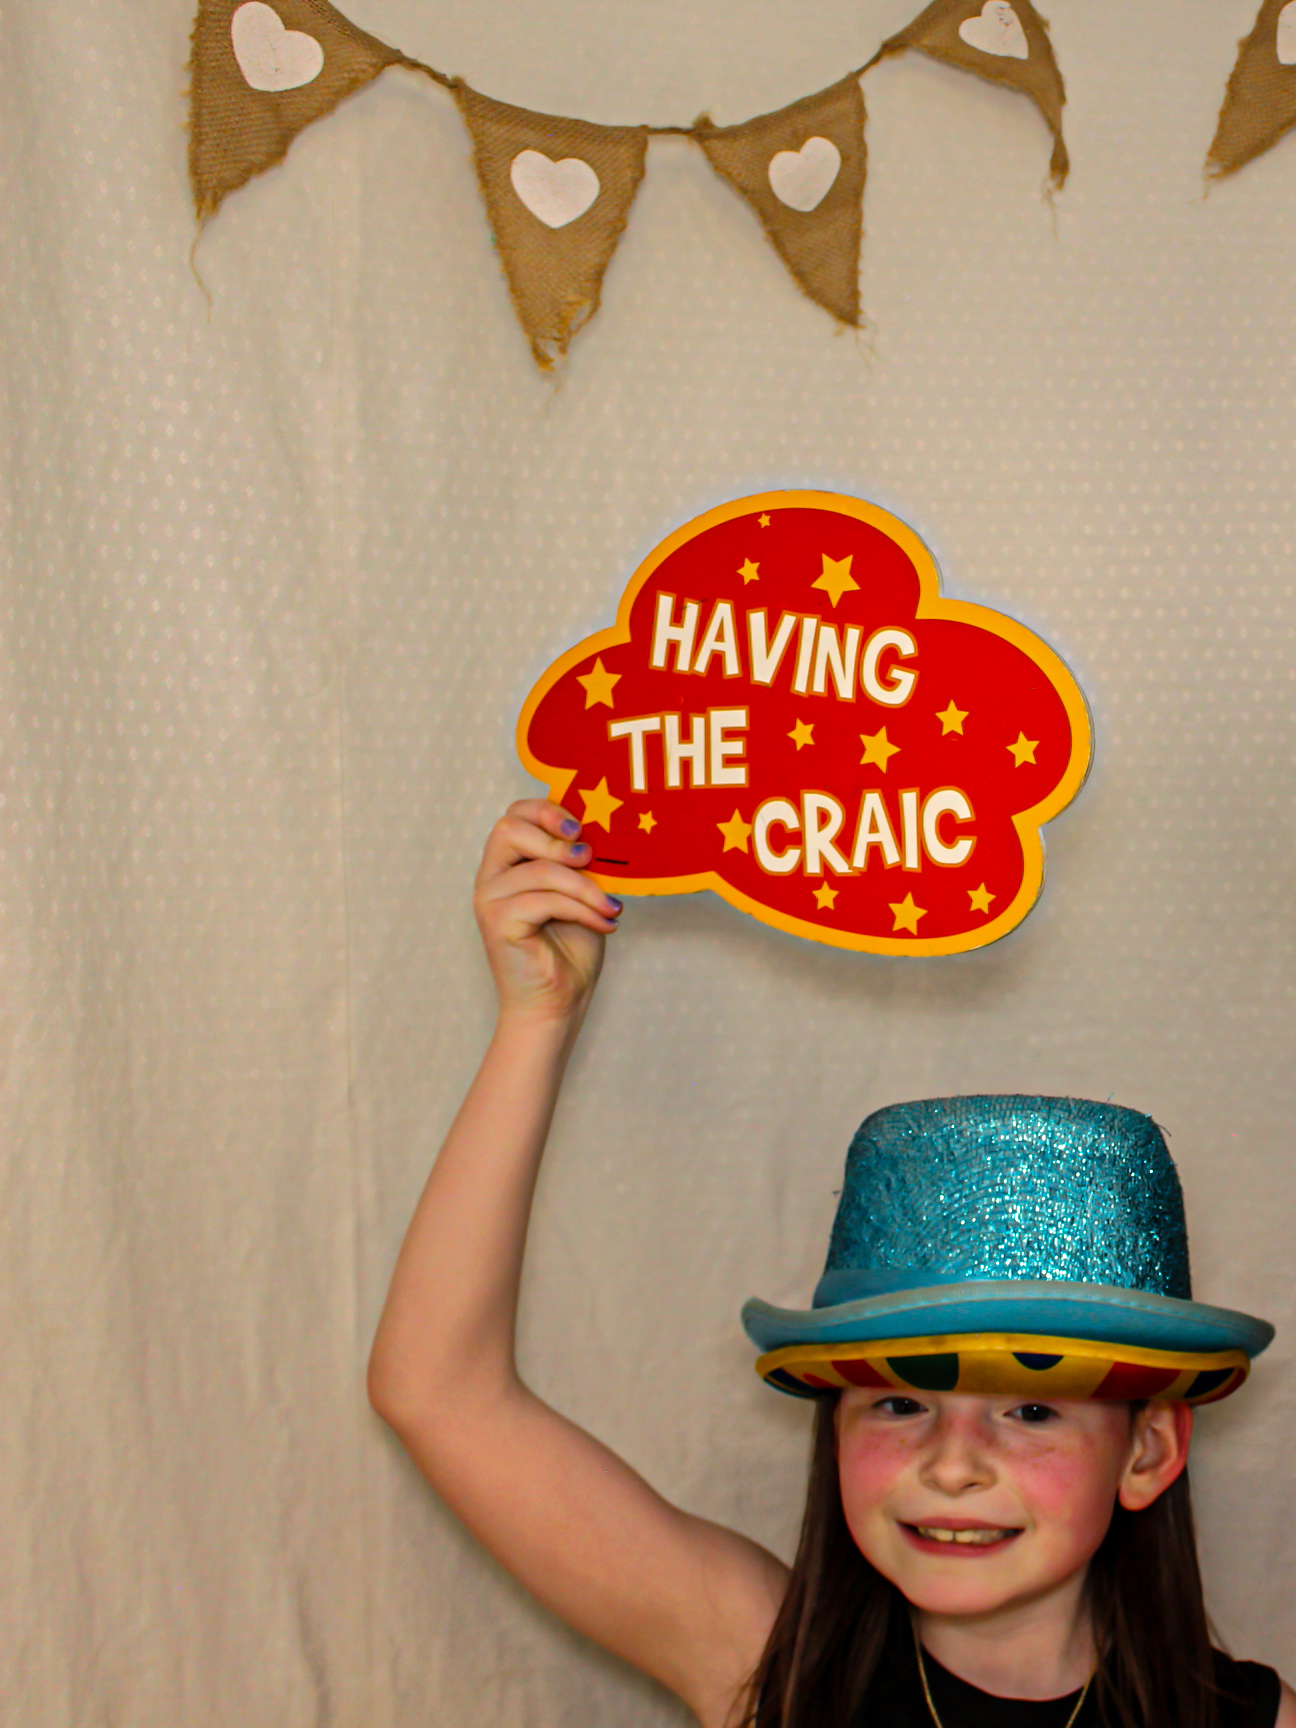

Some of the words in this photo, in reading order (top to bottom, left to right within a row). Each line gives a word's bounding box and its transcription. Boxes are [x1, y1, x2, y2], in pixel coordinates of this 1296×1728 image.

[650, 593, 918, 706] HAVING
[609, 709, 749, 791] THE
[753, 788, 975, 875] CRAIC
